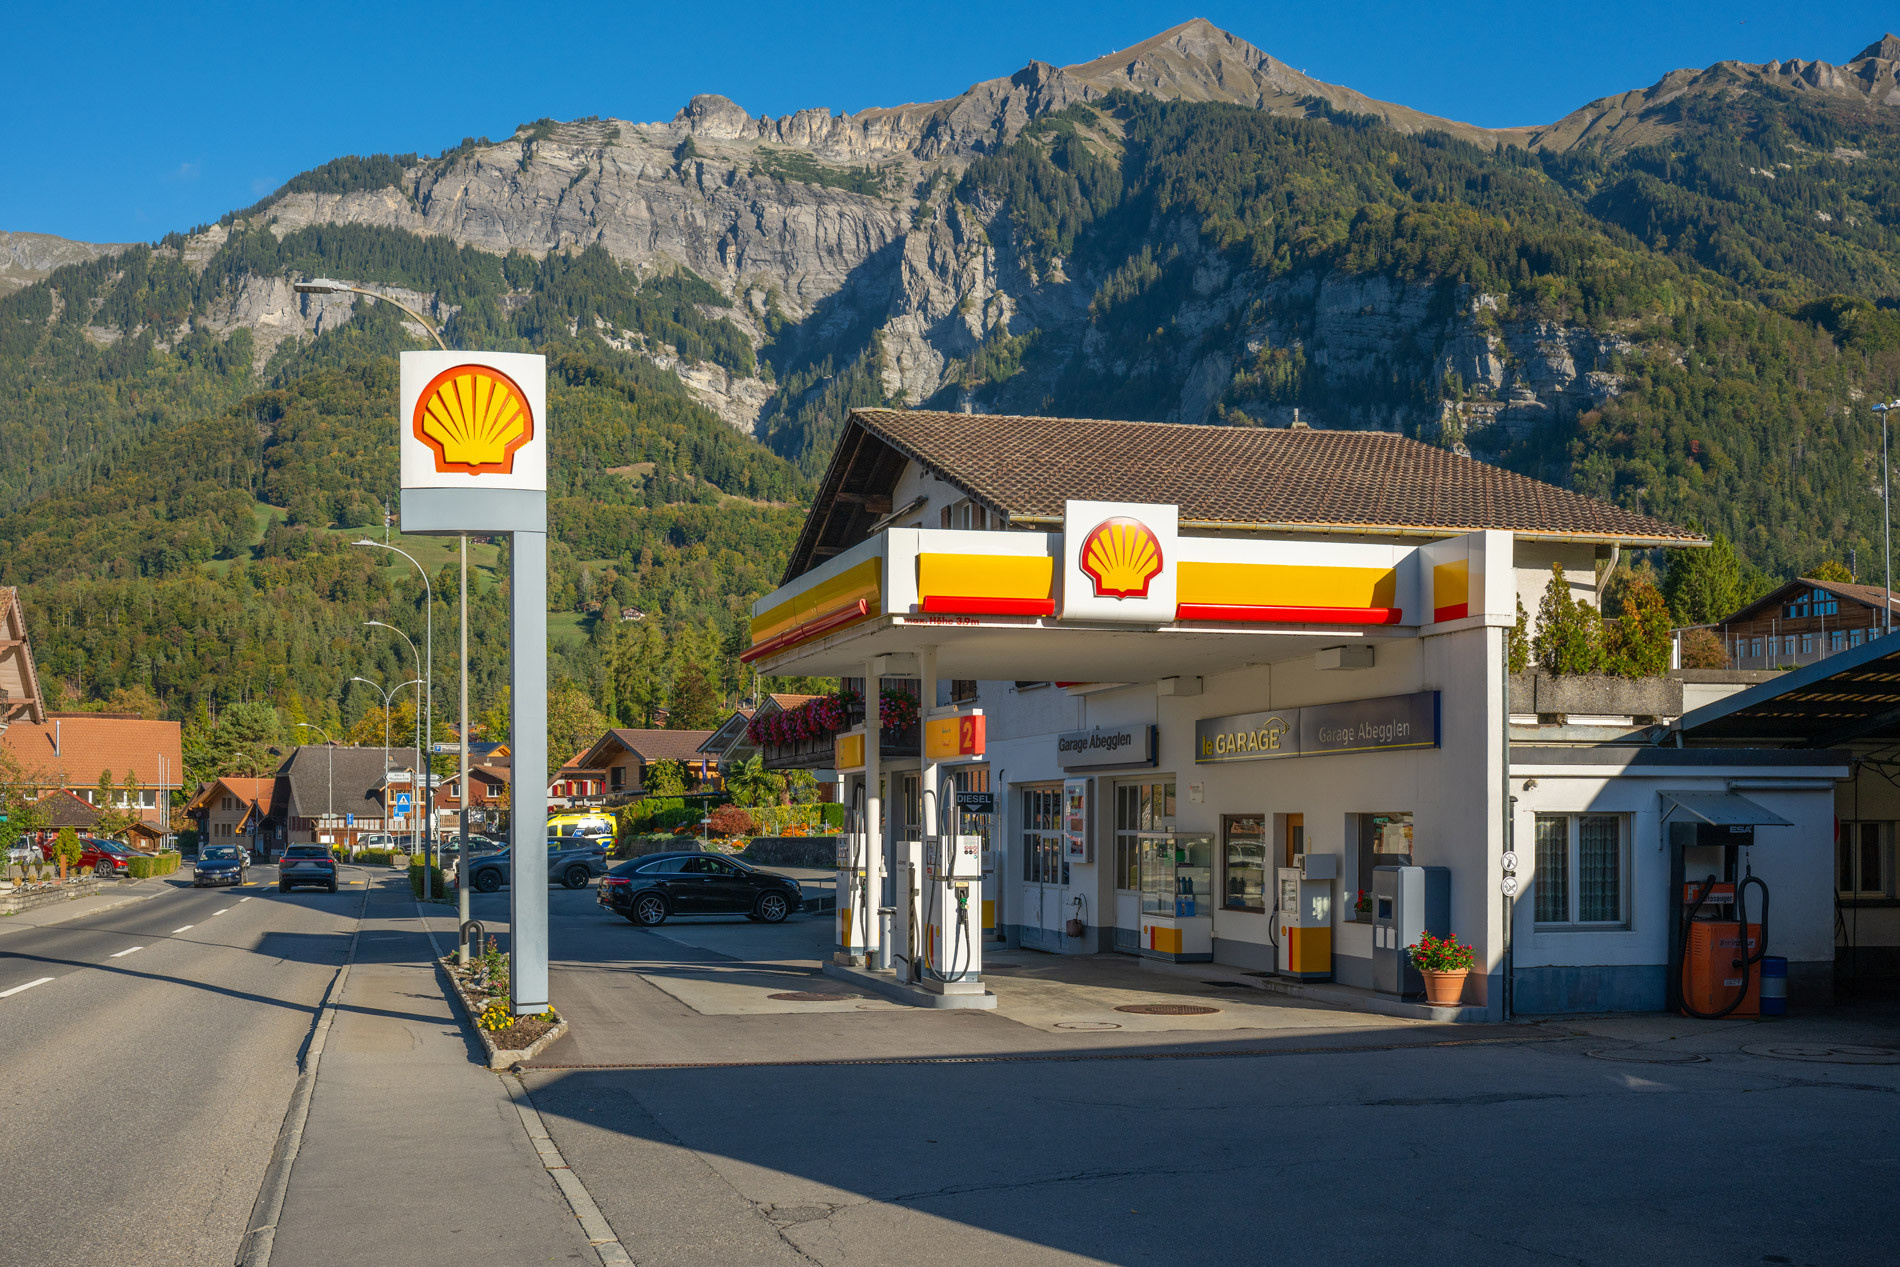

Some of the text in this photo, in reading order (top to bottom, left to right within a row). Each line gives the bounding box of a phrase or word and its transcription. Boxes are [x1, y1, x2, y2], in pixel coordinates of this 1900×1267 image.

[929, 616, 954, 625] Höhe
[963, 721, 972, 748] 2
[1059, 732, 1131, 753] Garage Abegglen
[1202, 729, 1281, 755] le GARAGE
[1318, 718, 1410, 745] Garage Abegglen
[957, 795, 991, 803] DIESEL
